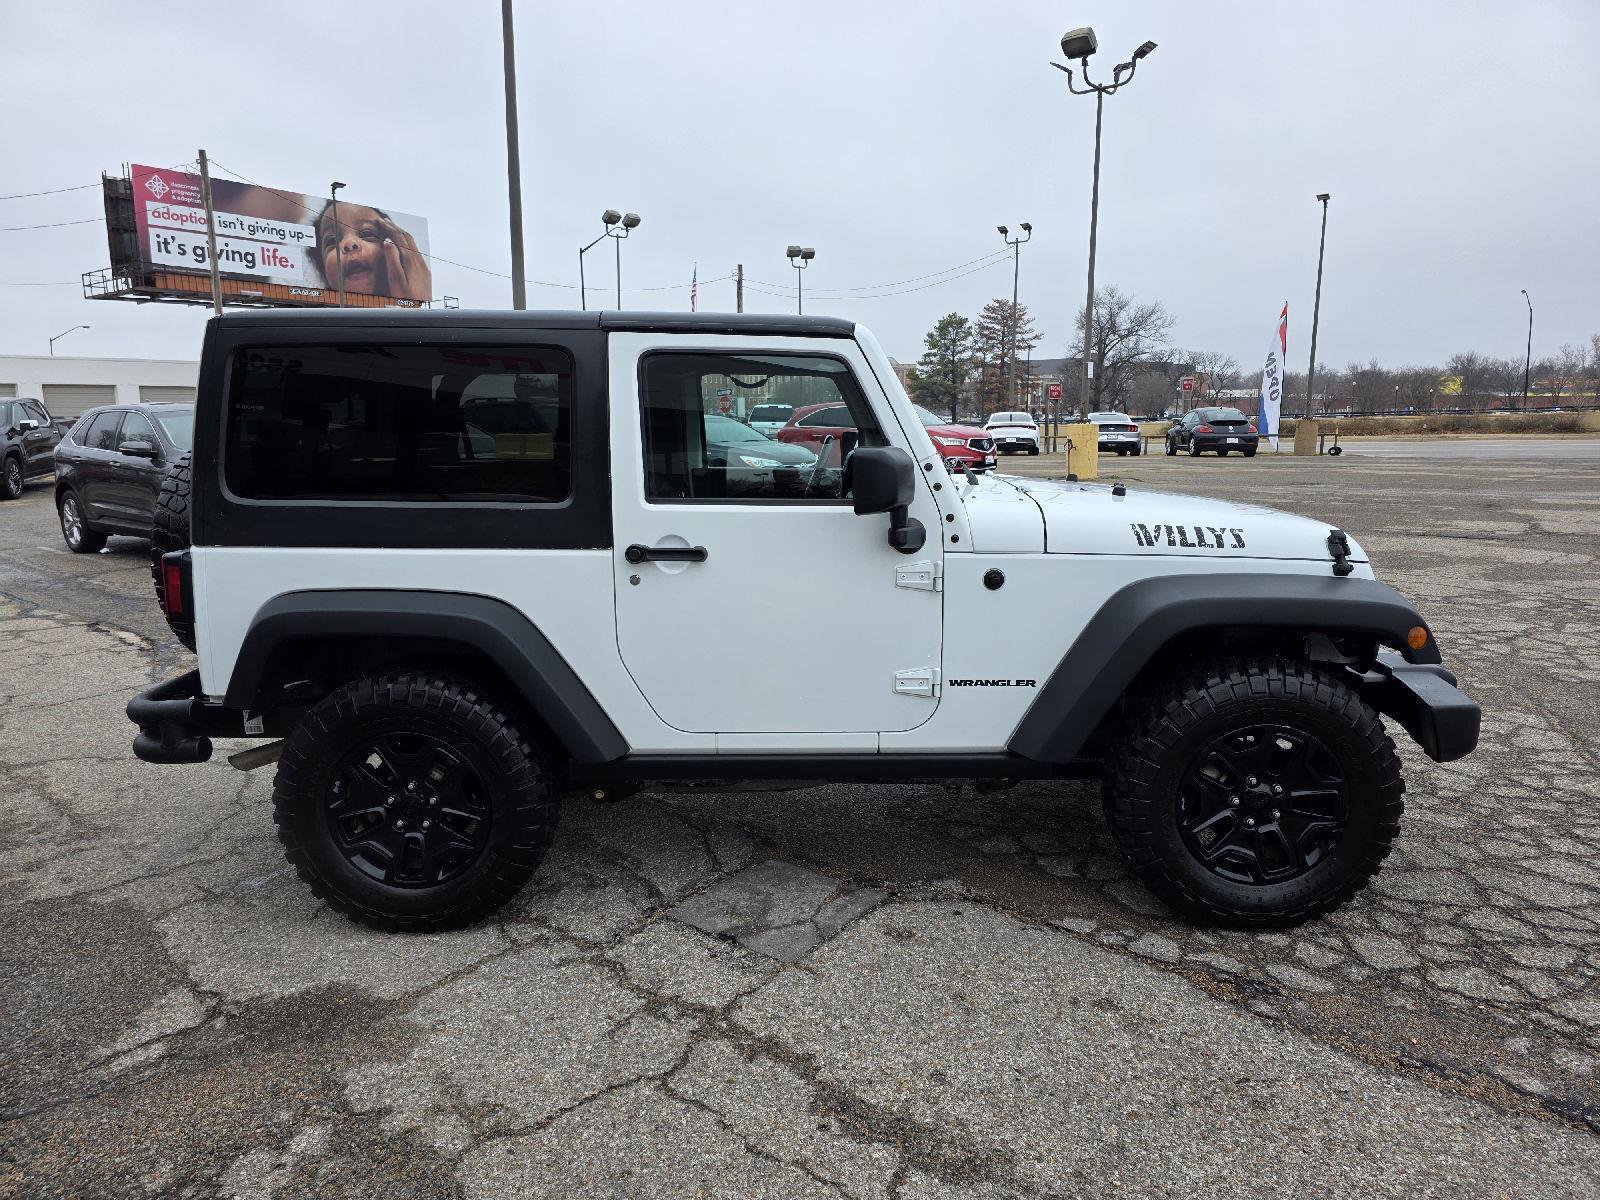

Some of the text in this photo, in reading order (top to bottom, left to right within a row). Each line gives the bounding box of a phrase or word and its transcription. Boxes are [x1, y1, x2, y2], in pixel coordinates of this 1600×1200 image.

[151, 207, 207, 225] adoptio
[247, 221, 286, 240] giving
[260, 246, 295, 269] life.
[1129, 523, 1246, 549] WILLYS
[948, 679, 1037, 688] WRANGLER
